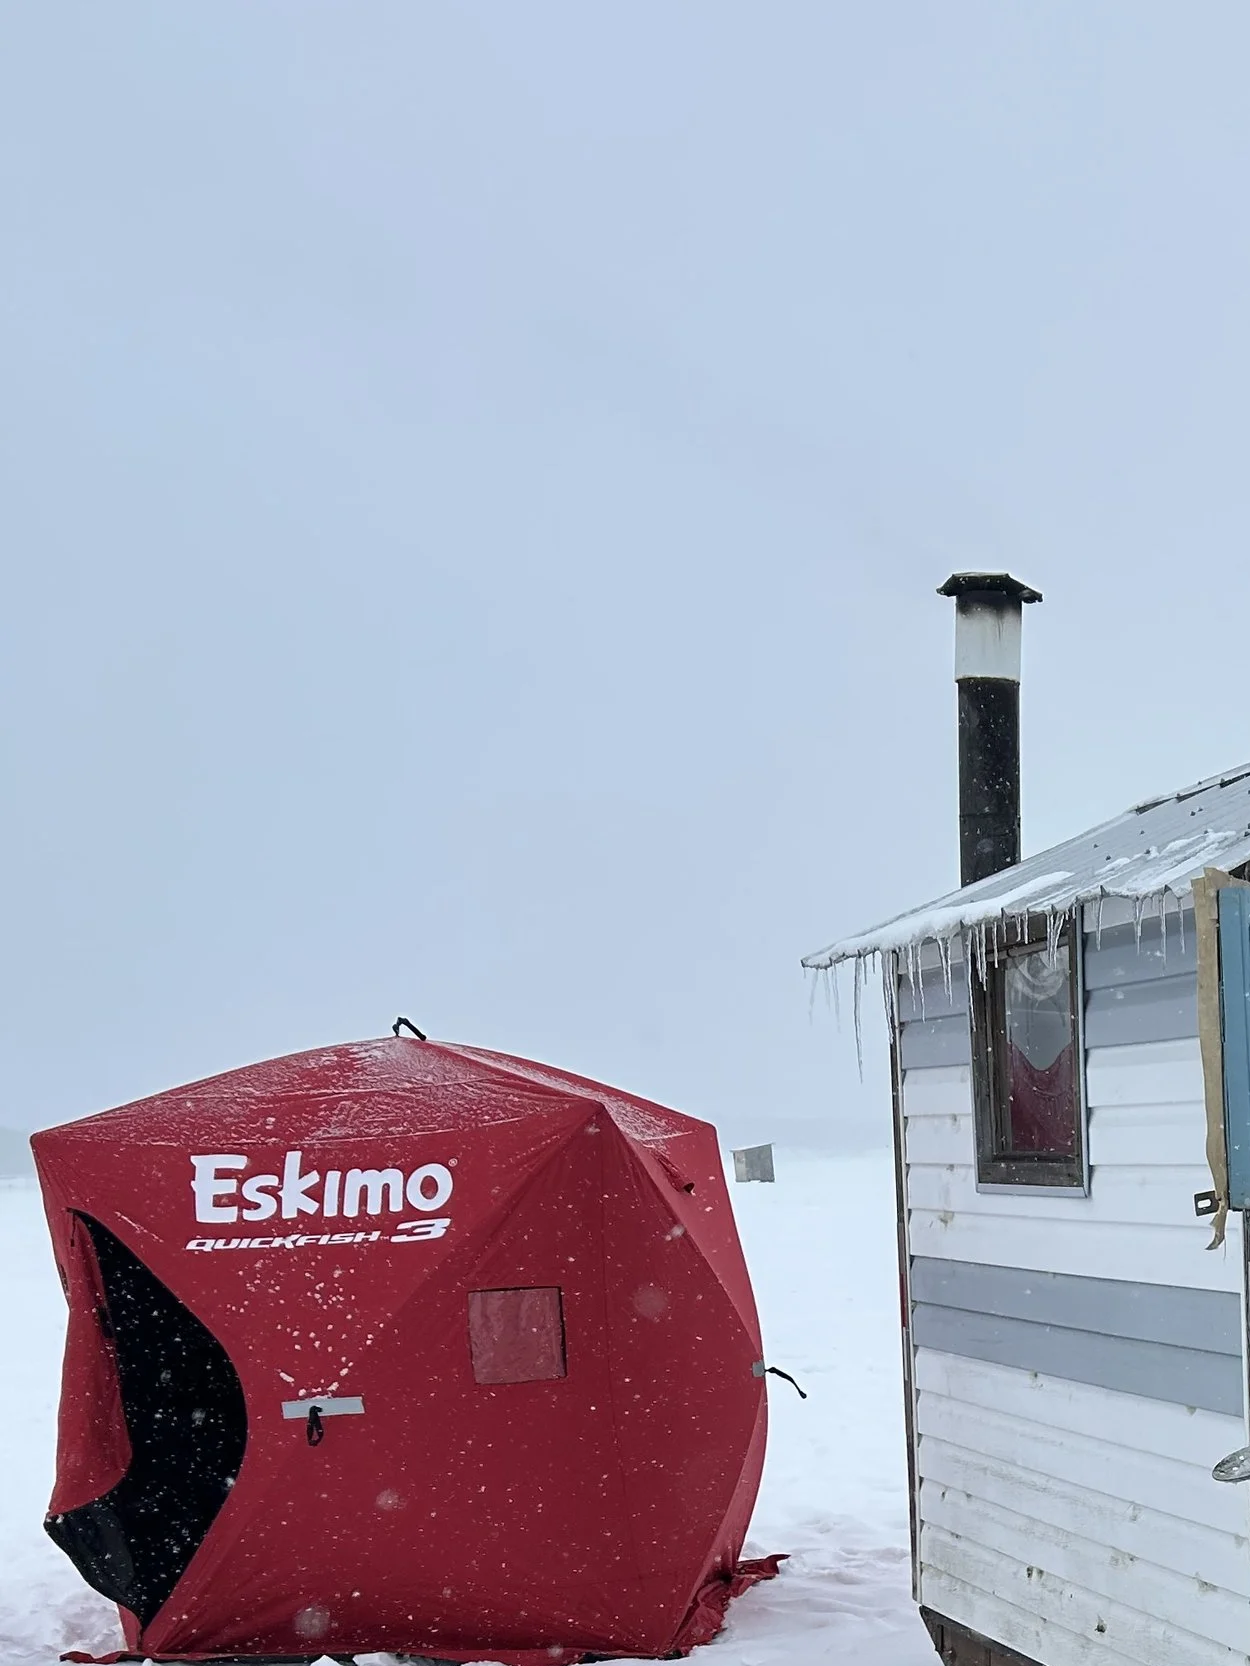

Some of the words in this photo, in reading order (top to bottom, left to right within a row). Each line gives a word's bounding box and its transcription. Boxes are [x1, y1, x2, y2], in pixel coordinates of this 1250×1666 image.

[190, 1150, 453, 1223] Eskimo
[186, 1230, 381, 1251] QUICKFISH
[390, 1217, 451, 1243] 3
